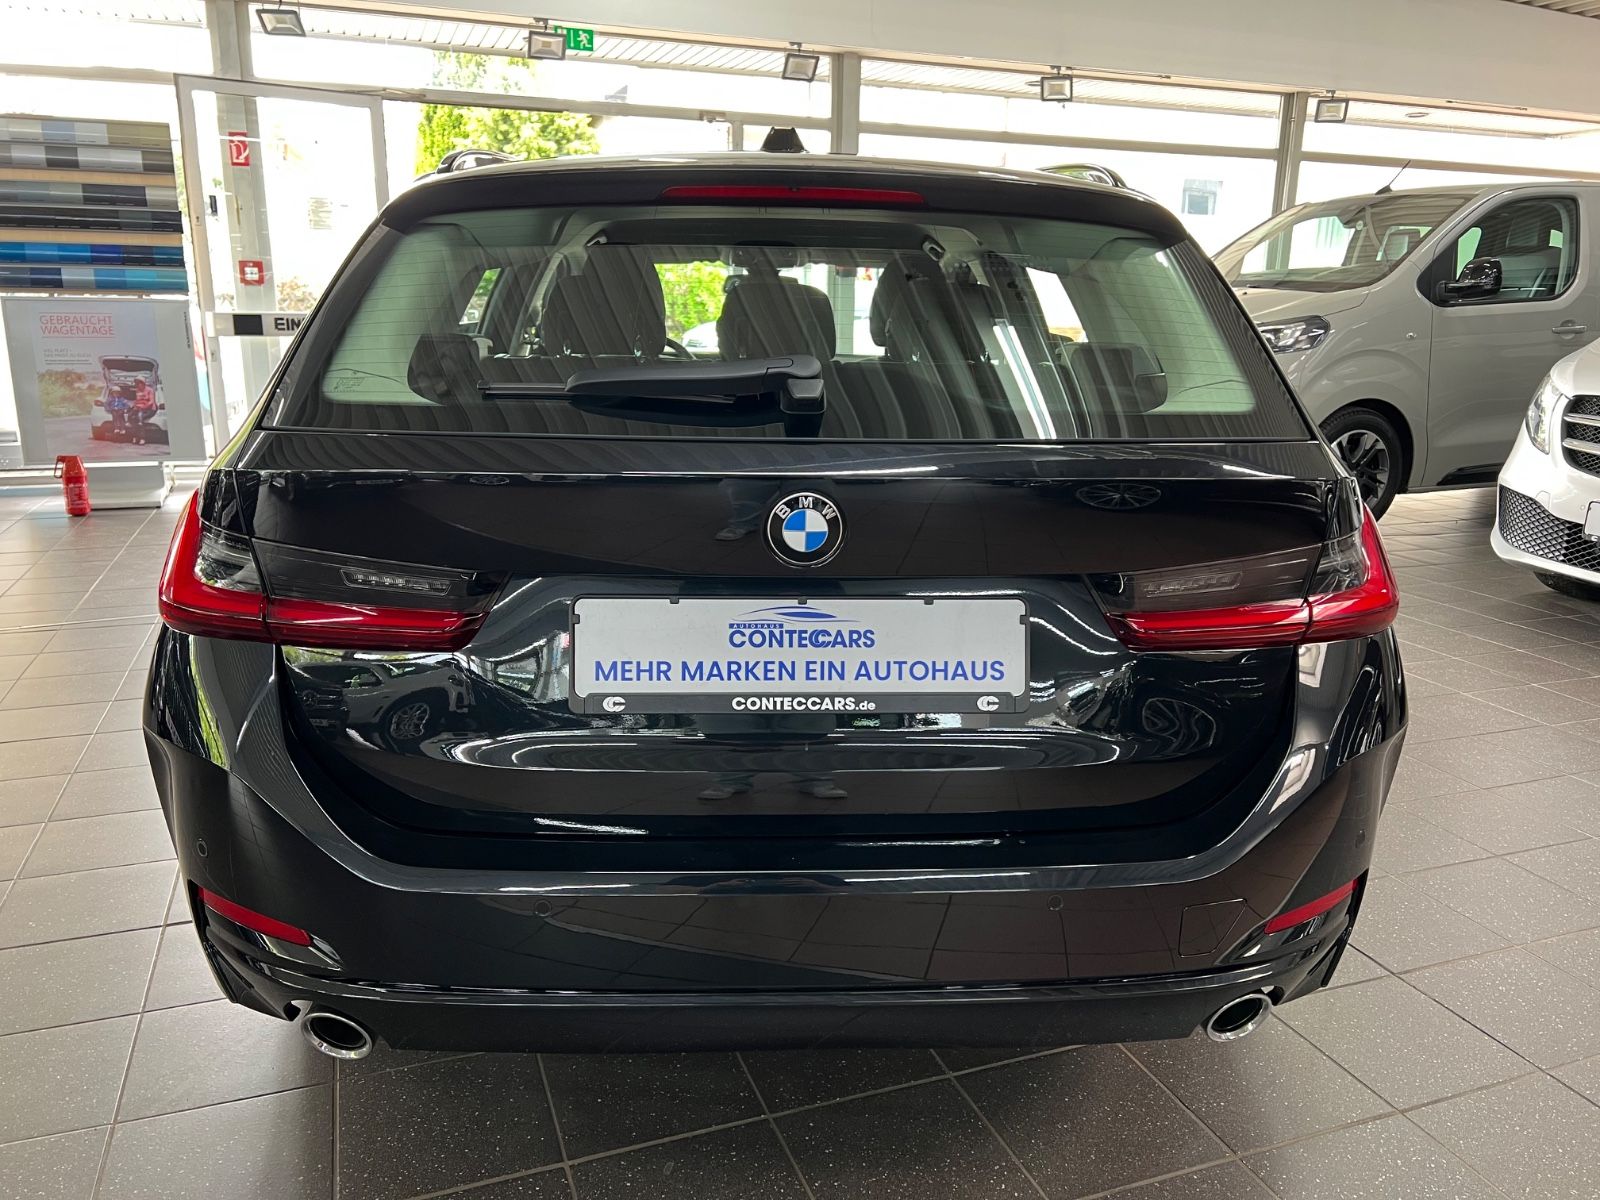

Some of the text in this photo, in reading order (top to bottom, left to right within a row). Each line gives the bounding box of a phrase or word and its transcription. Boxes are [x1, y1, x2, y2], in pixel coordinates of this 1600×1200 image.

[39, 315, 113, 325] GEBRAUCHT
[274, 317, 305, 331] EIN
[40, 325, 115, 336] WAGENTAGE
[775, 496, 836, 520] BMW
[728, 629, 876, 648] CONTECCARS
[594, 660, 1005, 682] MEHR MARKEN EIN AUTOHAUS
[731, 696, 876, 711] CONTECCARS.de
